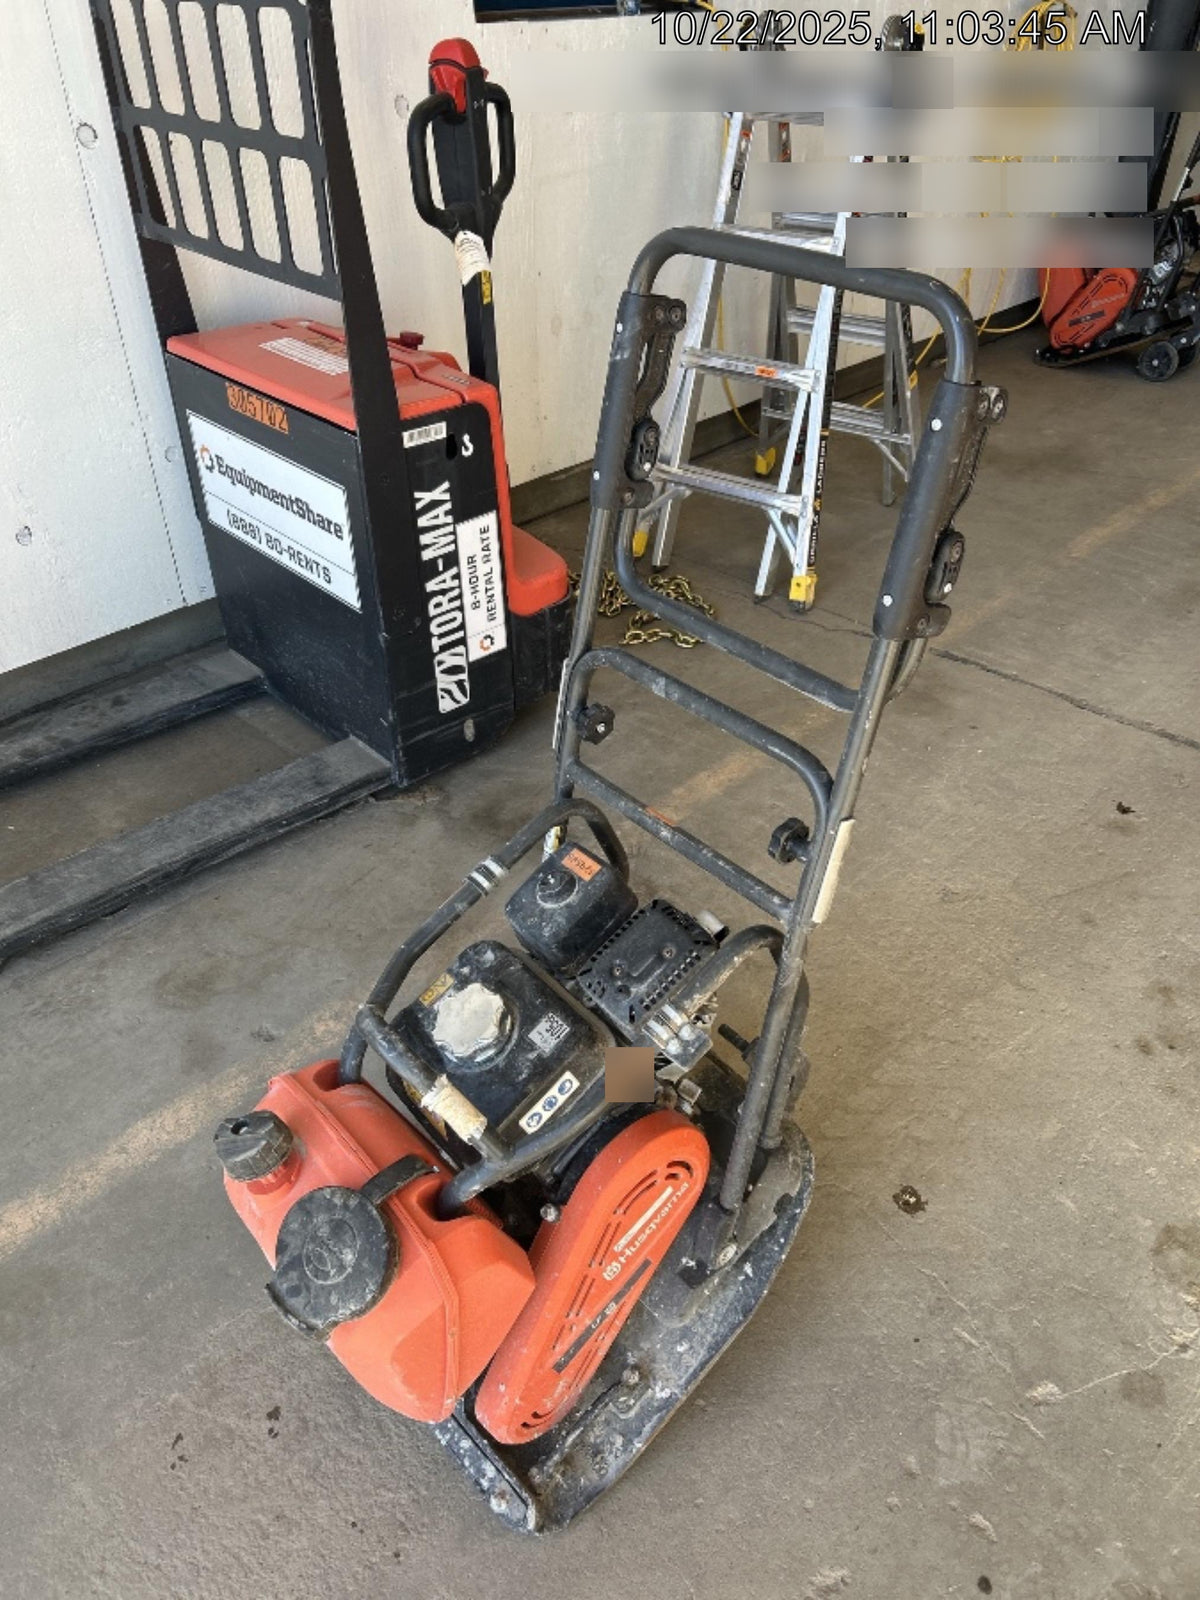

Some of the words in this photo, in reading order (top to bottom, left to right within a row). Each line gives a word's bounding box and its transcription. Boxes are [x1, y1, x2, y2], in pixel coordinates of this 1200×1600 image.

[215, 453, 344, 541] EquipmentShare
[226, 508, 262, 545] (888)
[479, 523, 493, 563] RATE
[414, 480, 466, 653] TORA-MAX
[466, 553, 481, 610] 8-HOUR
[485, 566, 498, 623] RENTAL
[619, 1181, 690, 1265] Husqvarna
